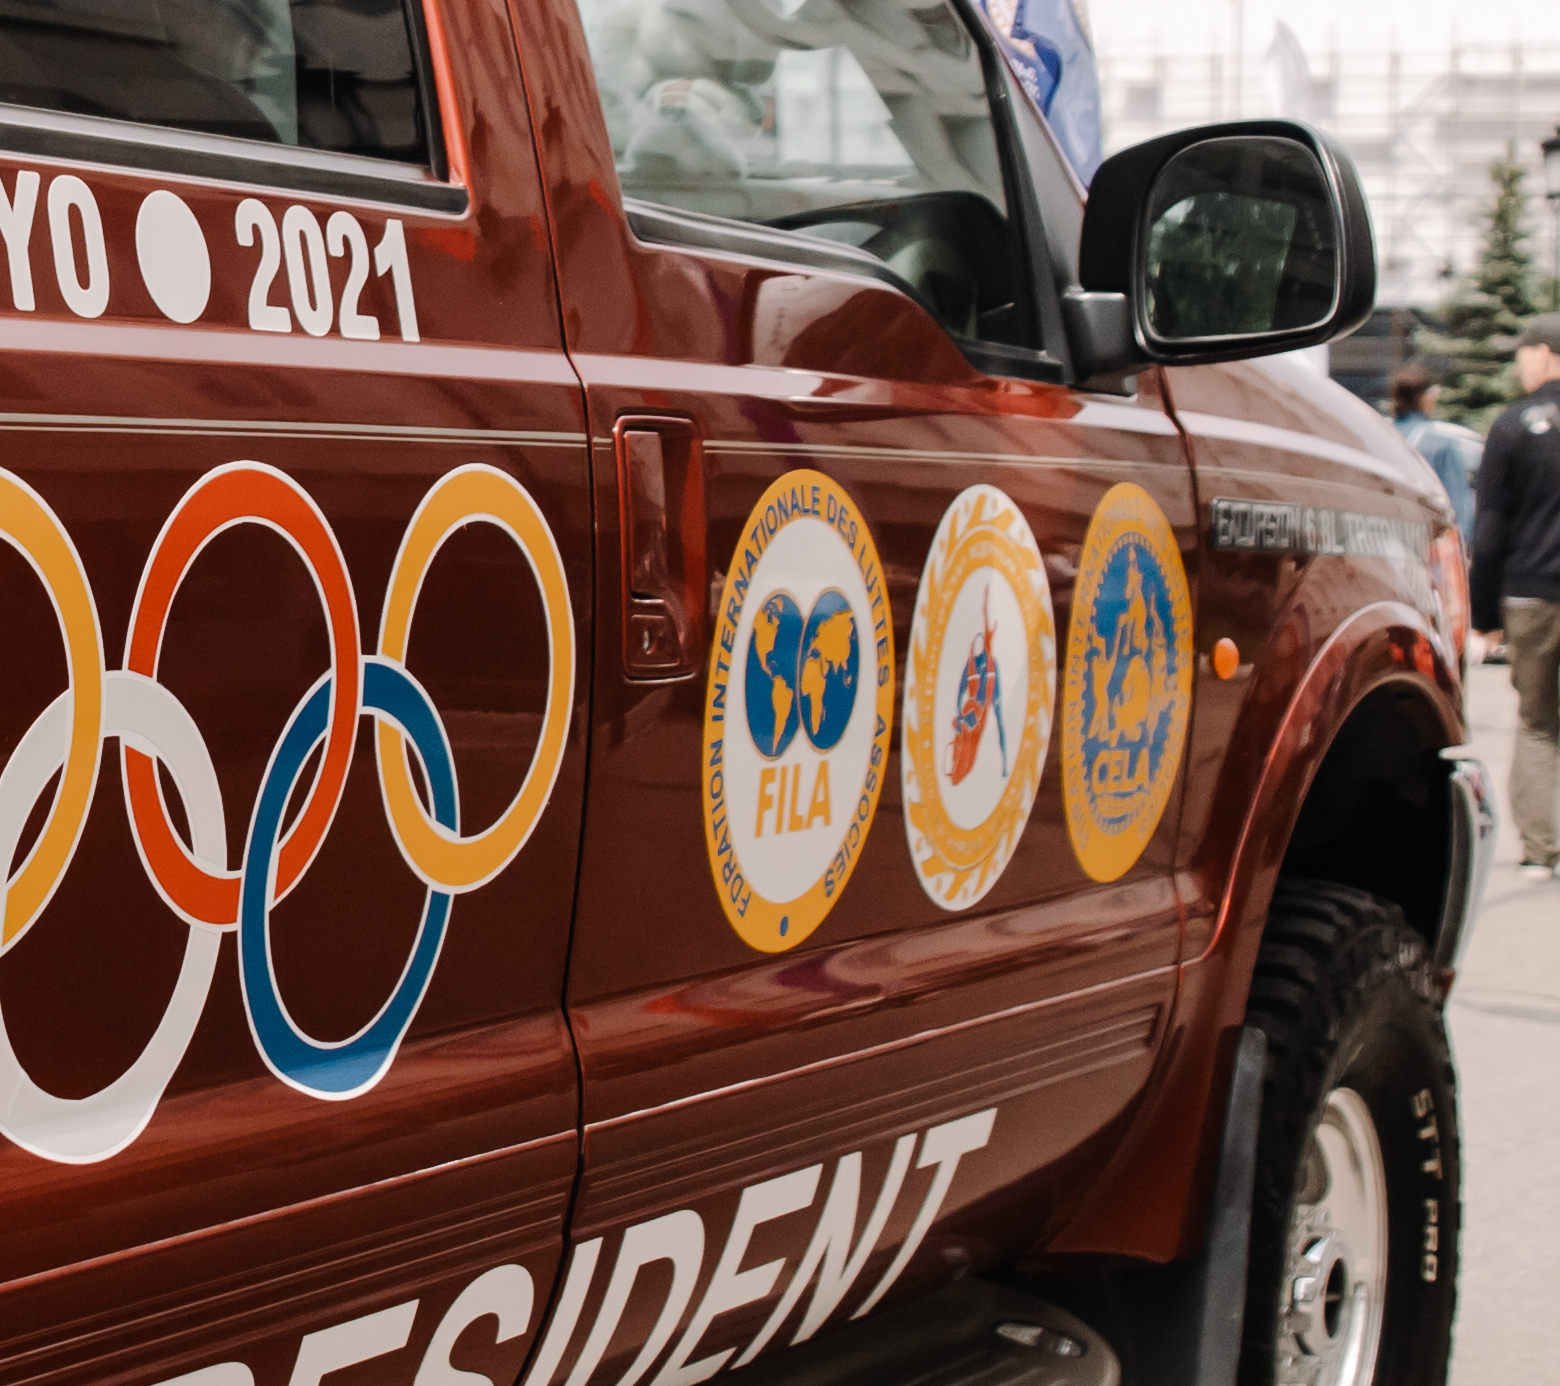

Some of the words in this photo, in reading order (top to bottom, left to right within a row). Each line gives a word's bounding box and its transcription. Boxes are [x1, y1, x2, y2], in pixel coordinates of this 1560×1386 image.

[234, 198, 421, 344] 2021
[711, 484, 821, 722] INTERNATIONALE
[826, 492, 859, 550] DES
[754, 759, 832, 839] FILA
